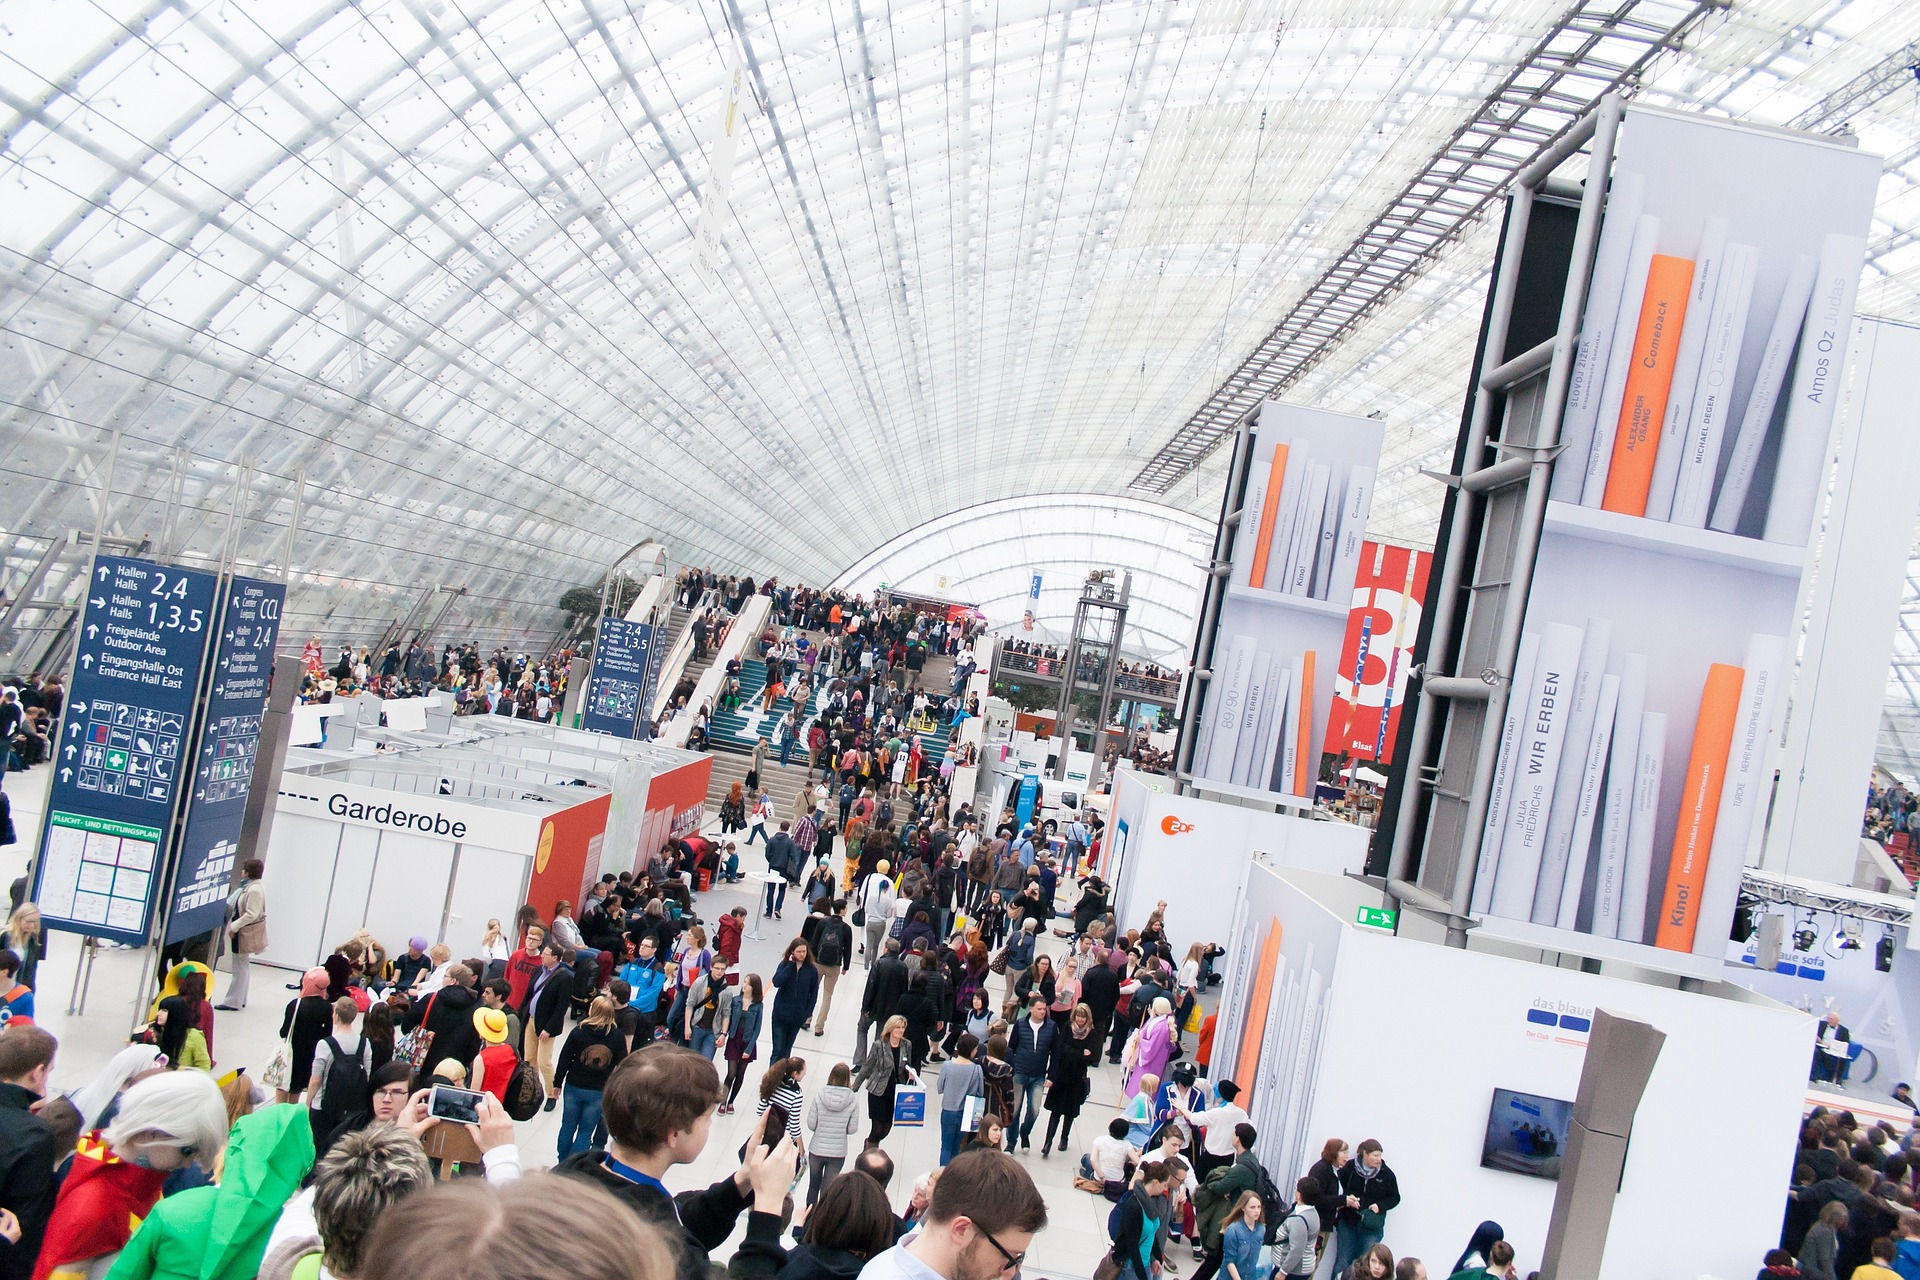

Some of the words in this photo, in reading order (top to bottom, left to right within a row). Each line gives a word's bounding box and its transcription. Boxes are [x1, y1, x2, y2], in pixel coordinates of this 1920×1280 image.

[1822, 276, 1846, 326] Judas
[1642, 300, 1670, 369] Comeback
[1816, 328, 1836, 353] Oz
[1716, 352, 1724, 363] Der
[1806, 356, 1832, 403] Amos
[1624, 394, 1646, 451] ALEXANDER
[1637, 407, 1651, 442] OSANG
[1695, 425, 1708, 463] MICHAEL
[1703, 394, 1715, 424] DEGEN
[1350, 485, 1364, 519] Comeback
[115, 578, 138, 591] Halls
[117, 565, 147, 579] Hallen
[1295, 564, 1306, 587] Kino!
[151, 573, 188, 600] 2,4
[244, 586, 264, 598] Congress
[109, 607, 133, 620] Halls
[112, 594, 142, 608] Hallen
[260, 598, 279, 620] CCL
[149, 602, 203, 633] 1,3,5
[626, 624, 642, 636] 2,4
[106, 623, 160, 642] Freigelände
[253, 626, 271, 651] 2,4
[624, 636, 648, 650] 1,3,5
[104, 636, 142, 652] Outdoor
[144, 644, 167, 656] Area
[98, 665, 139, 681] Entrance
[141, 673, 160, 685] Hall
[162, 677, 183, 689] East
[101, 652, 165, 673] Eingangshalle
[167, 665, 184, 677] Ost
[1755, 669, 1768, 696] GELDES
[93, 702, 113, 712] EXIT
[1217, 688, 1243, 730] 89/90
[1248, 684, 1260, 712] ERBEN
[1535, 671, 1560, 734] ERBEN
[1752, 695, 1763, 709] DES
[1245, 713, 1254, 729] WIR
[1743, 709, 1760, 751] PHILOSOPHIE
[112, 730, 131, 741] Shop
[1284, 747, 1294, 778] Aberland
[1527, 740, 1546, 776] WIR
[1590, 731, 1603, 770] Montecristo
[1739, 750, 1752, 773] MEHR!
[129, 778, 142, 787] IBL
[1489, 786, 1503, 827] ENDSTATION
[1497, 741, 1512, 785] ISLAMISCHER
[1505, 716, 1516, 740] STAAT?
[1585, 774, 1595, 792] Suter
[1694, 763, 1711, 811] Donnersmarck
[327, 793, 467, 838] Garderobe
[1513, 798, 1529, 828] JULIA
[1522, 784, 1543, 847] FRIEDRICHS
[1581, 793, 1591, 817] Martin
[1693, 811, 1701, 824] von
[53, 814, 83, 825] FLUCHT-
[84, 820, 101, 829] UND
[102, 823, 159, 839] RETTUNGSPLAN
[1609, 833, 1617, 843] the
[1682, 849, 1694, 874] Florian
[1603, 865, 1614, 893] DORON
[1601, 894, 1611, 917] LIZZIE
[1668, 883, 1690, 927] Kino!
[1746, 944, 1758, 954] da
[1802, 955, 1825, 967] sofa
[1533, 996, 1554, 1010] das
[1557, 1000, 1593, 1017] blaue
